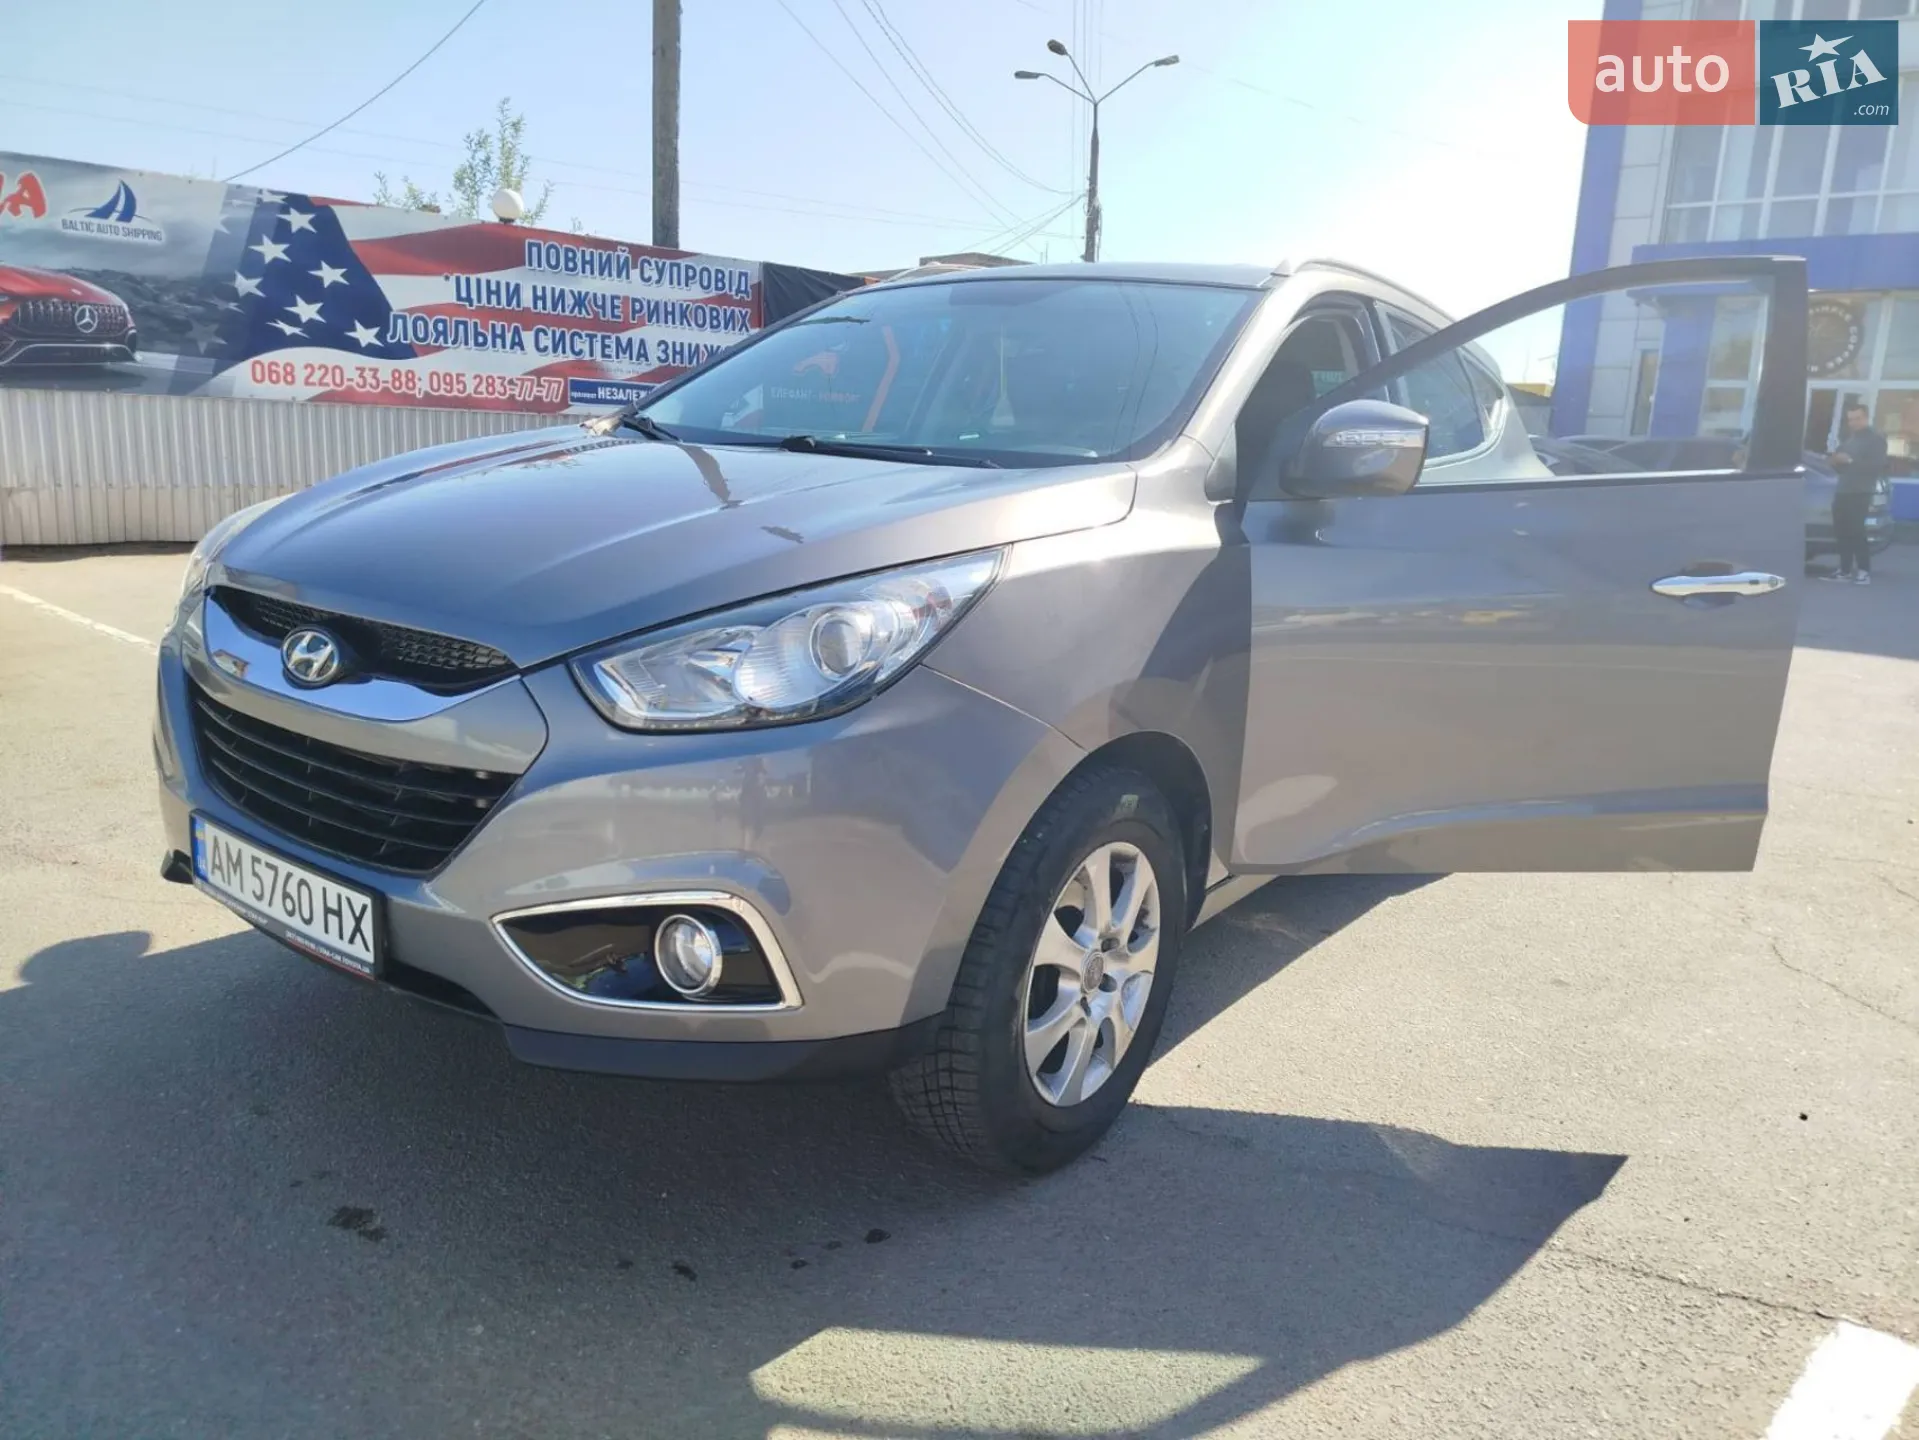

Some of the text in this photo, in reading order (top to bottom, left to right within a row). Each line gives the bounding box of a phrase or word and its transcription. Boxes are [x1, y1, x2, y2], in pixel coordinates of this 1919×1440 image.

[61, 218, 163, 241] BALTIC AUTO SHIPPING
[526, 240, 752, 299] ПОВНИЙ СУПРОВІД
[531, 284, 623, 321] НИЖЧЕ
[630, 298, 750, 333] РИНКОВИХ
[389, 313, 524, 353] ЛОЯЛЬНА
[534, 327, 650, 363] СИСТЕМА
[251, 359, 565, 402] 068 220-33-88; 095 283-77-77
[211, 834, 244, 893] AM
[251, 855, 314, 926] 5760
[322, 886, 371, 953] HX
